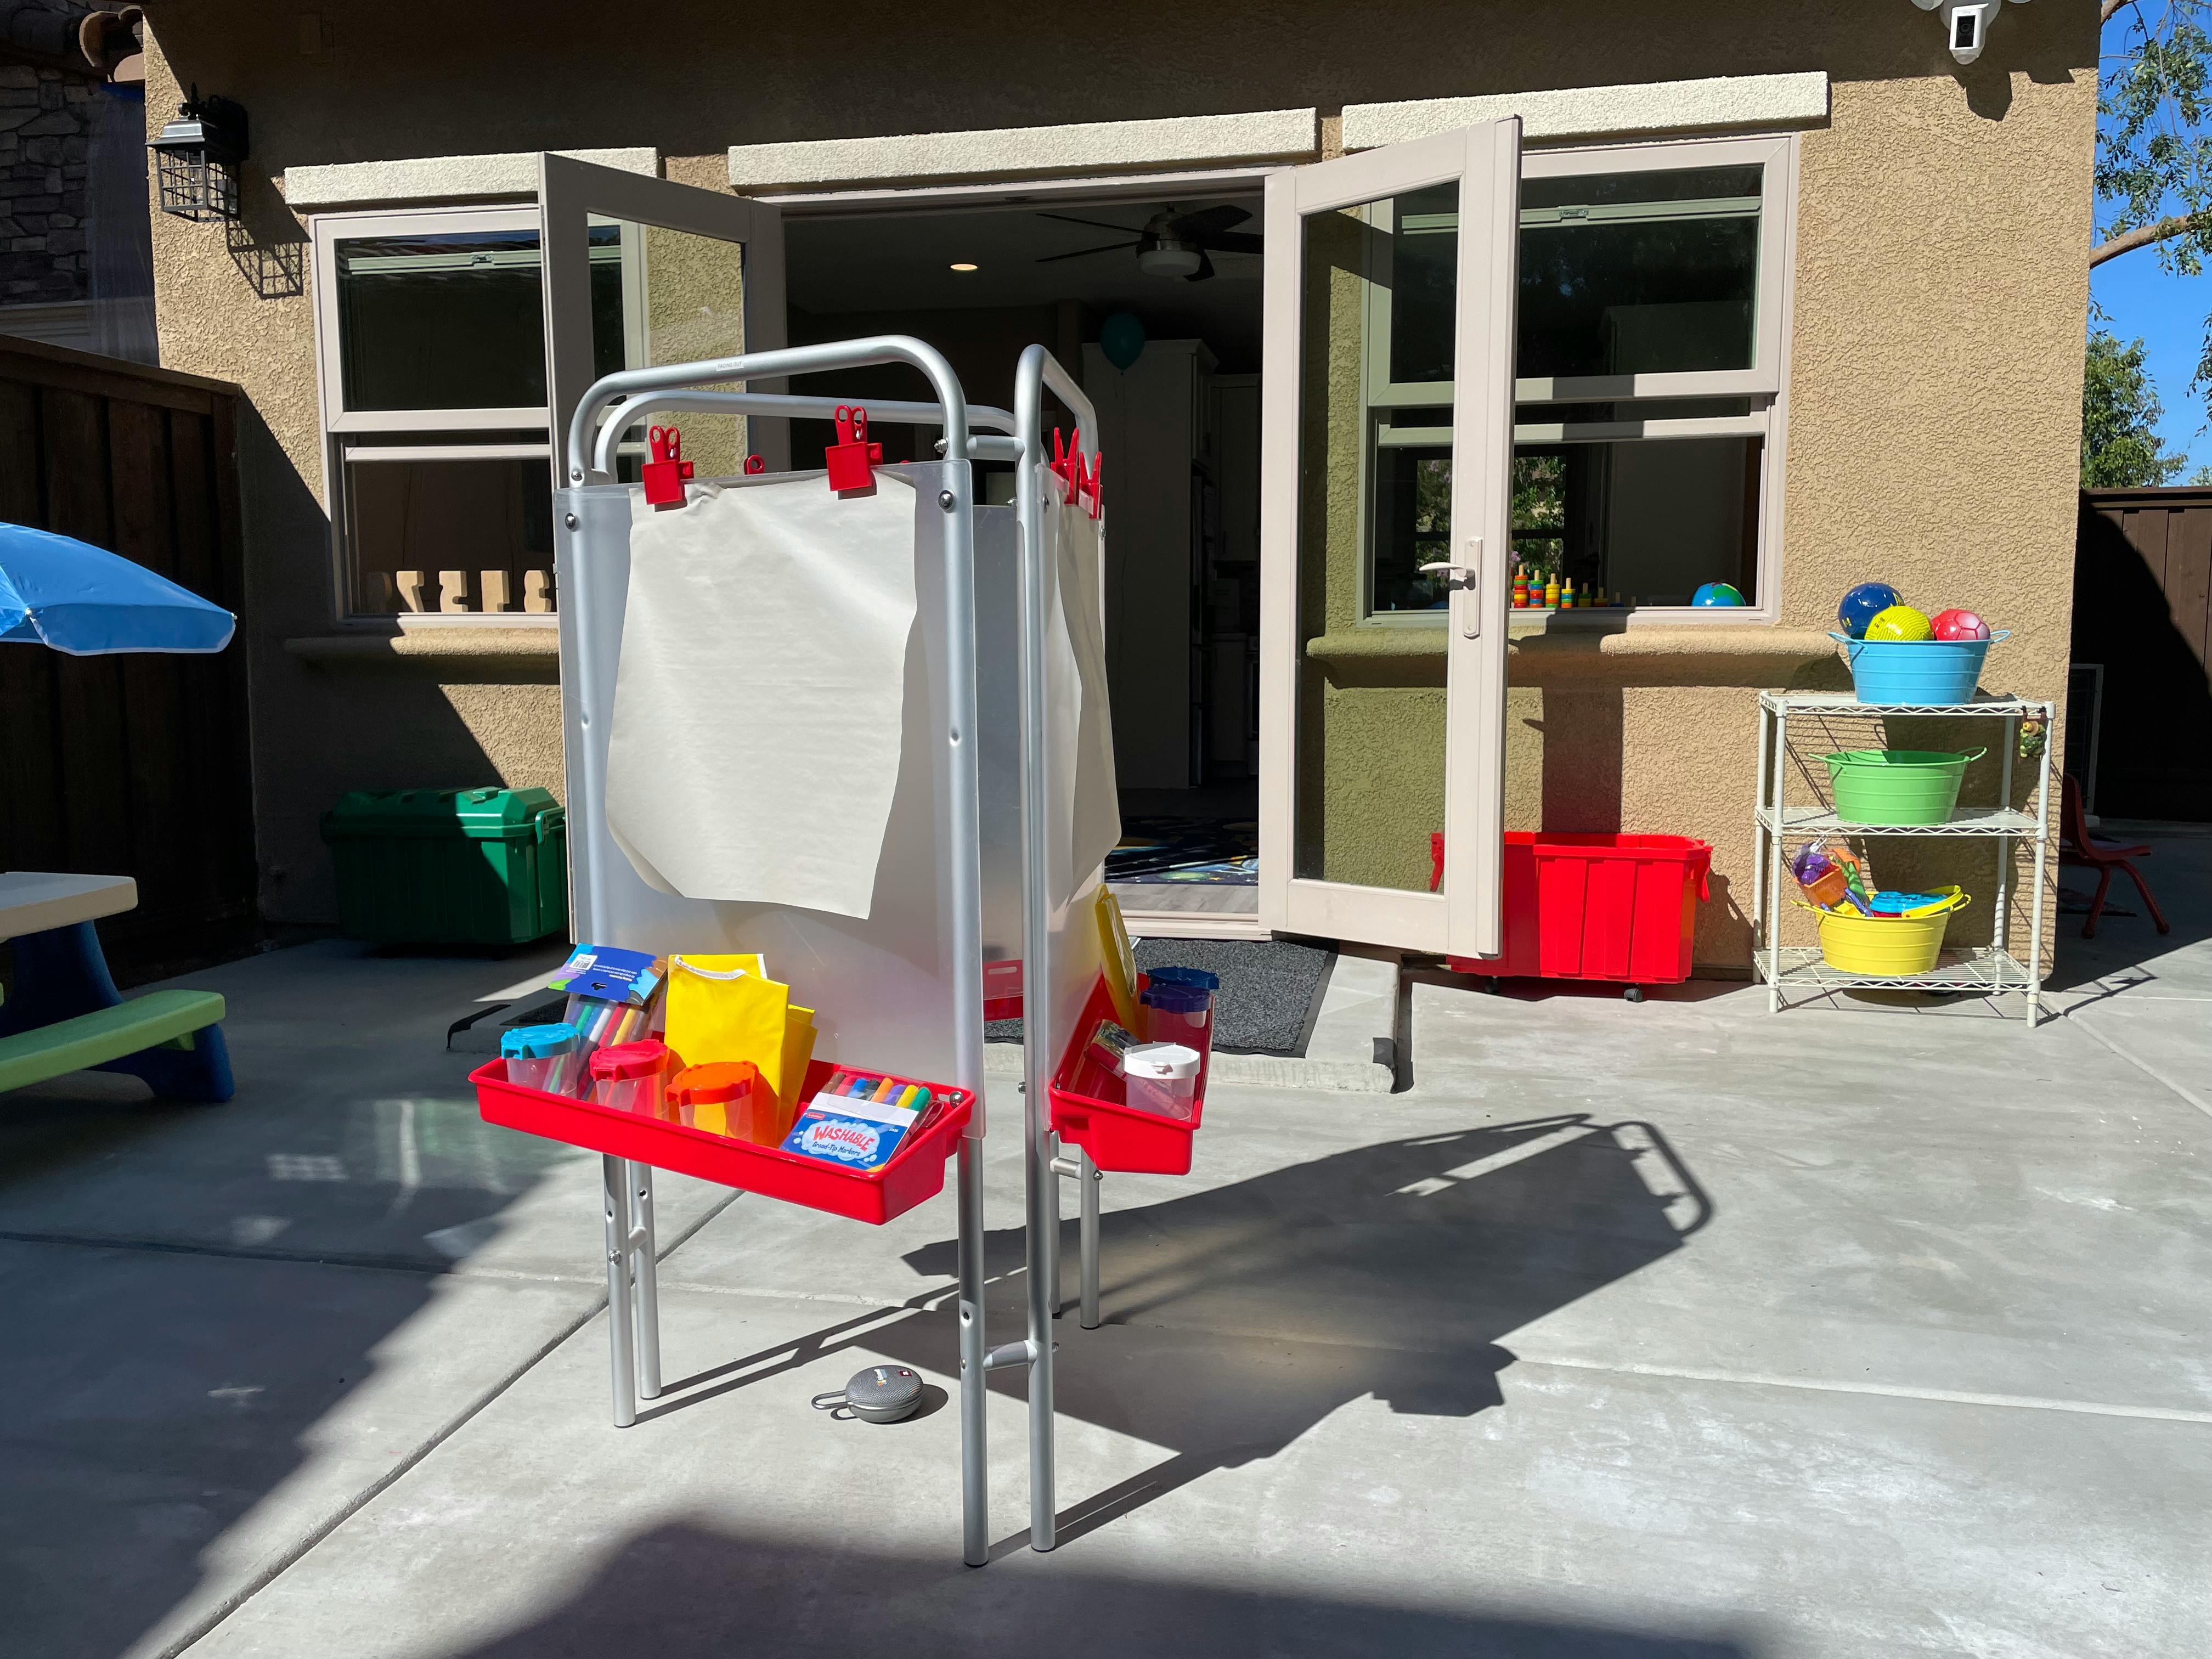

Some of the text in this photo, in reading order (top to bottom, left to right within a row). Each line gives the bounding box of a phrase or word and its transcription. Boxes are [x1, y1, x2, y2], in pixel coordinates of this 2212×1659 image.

[812, 1141, 861, 1156] Broad-Tip Markers
[813, 1125, 875, 1152] WASHABLE
